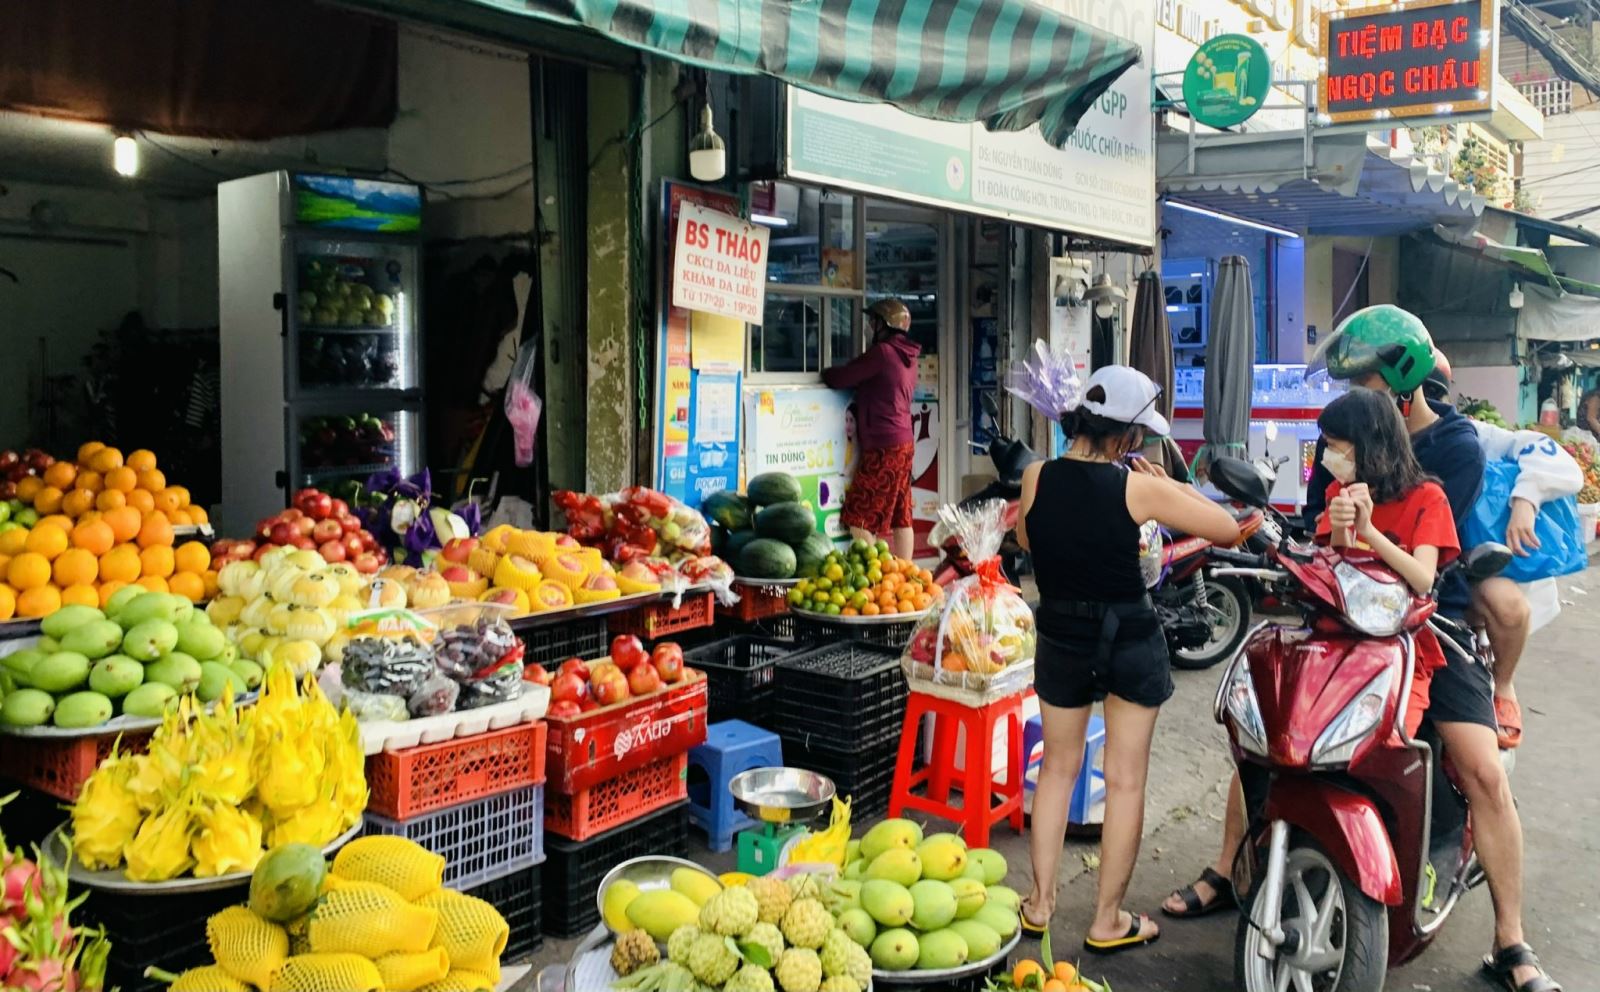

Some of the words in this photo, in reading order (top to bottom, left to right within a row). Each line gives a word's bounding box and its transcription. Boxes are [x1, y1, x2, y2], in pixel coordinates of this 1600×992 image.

[1338, 24, 1403, 59] TIỆM
[1412, 17, 1469, 50] BẠC
[1328, 71, 1395, 102] NGỌC
[1404, 58, 1480, 93] CHÂU
[1101, 89, 1128, 119] GPP
[685, 219, 709, 249] BS
[715, 226, 761, 264] THẢO
[717, 261, 731, 273] DA
[719, 280, 732, 292] DA
[765, 453, 779, 465] TIN
[695, 477, 727, 490] POCARI
[632, 715, 672, 748] envy
